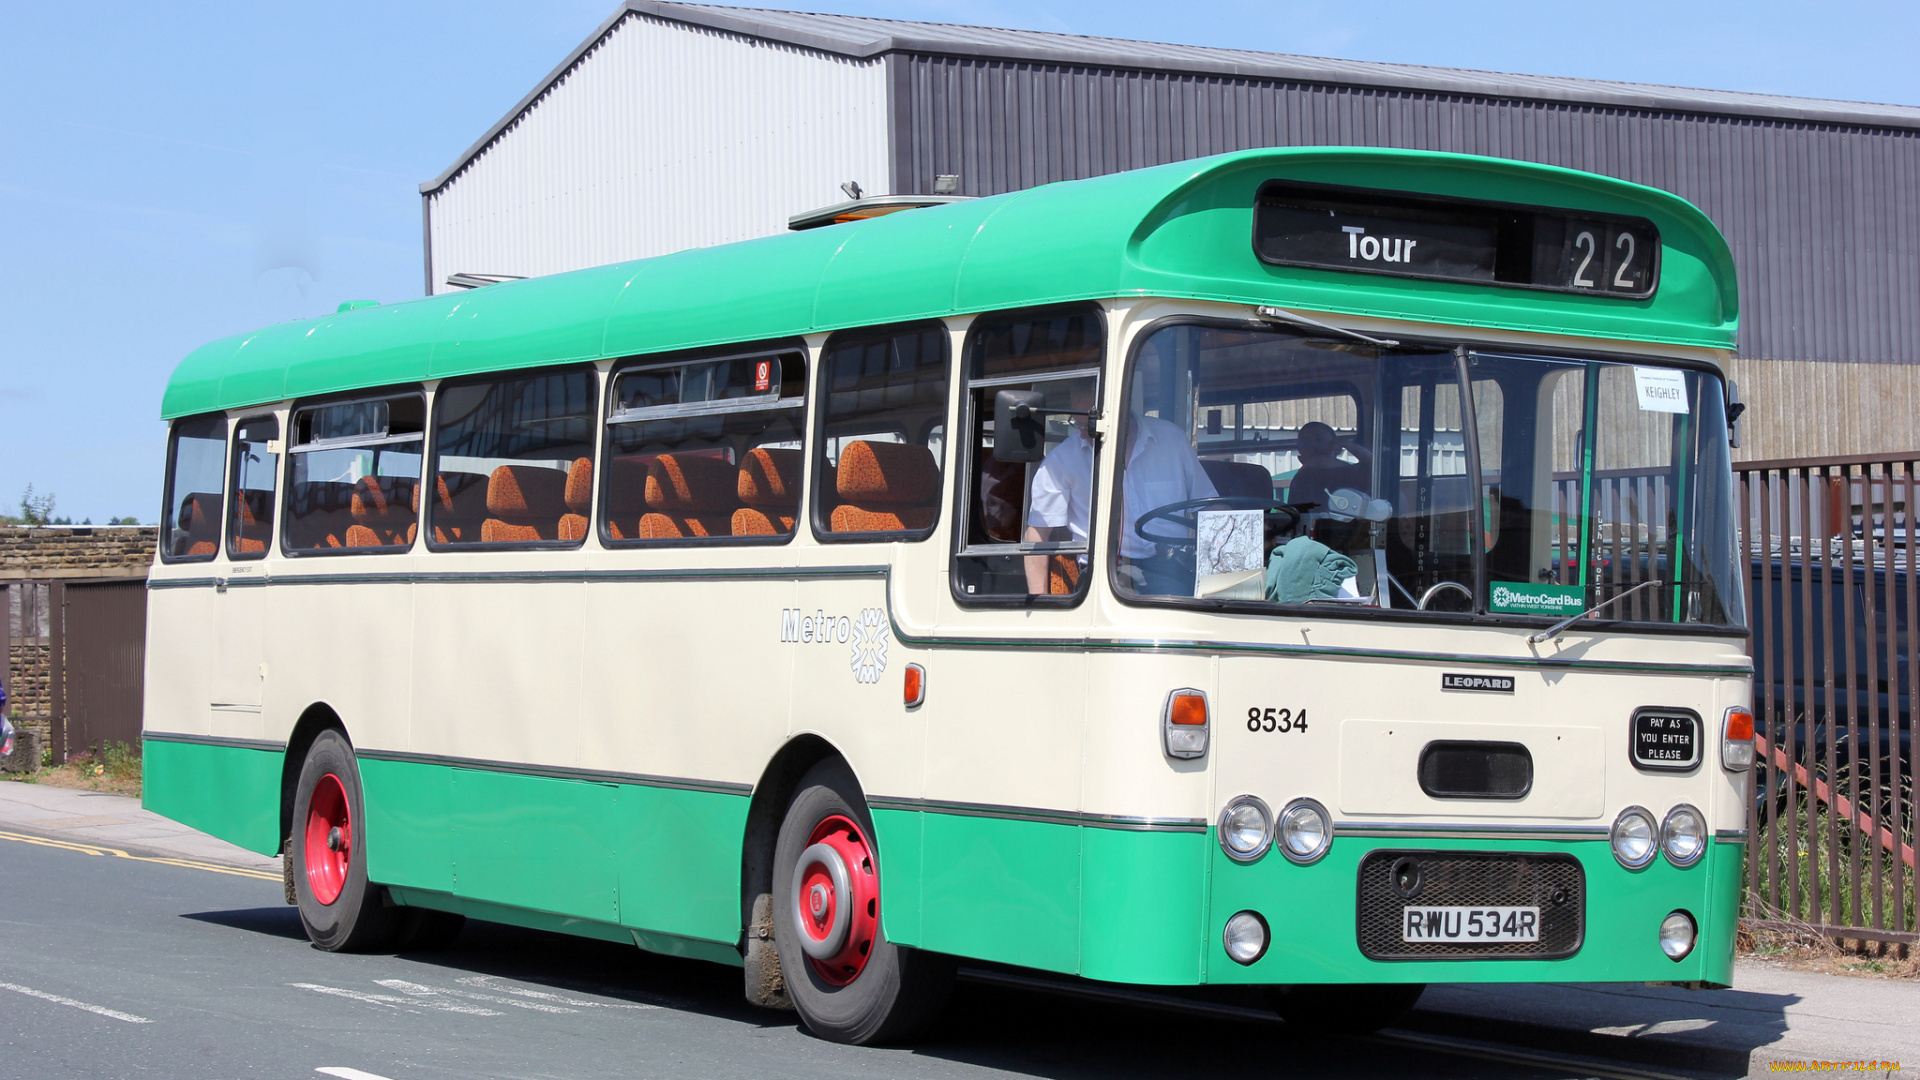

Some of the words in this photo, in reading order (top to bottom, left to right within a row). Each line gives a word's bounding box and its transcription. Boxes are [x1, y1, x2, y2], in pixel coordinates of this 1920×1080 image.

[1342, 225, 1417, 263] Tour
[1644, 385, 1680, 400] KEIGHLEY
[1509, 592, 1564, 606] MetroCard
[1564, 595, 1583, 606] Bus
[781, 608, 851, 643] Metro
[1444, 676, 1512, 689] LEOPARD
[1247, 707, 1308, 733] 8534
[1650, 718, 1665, 728] PAY
[1669, 719, 1681, 729] AS
[1641, 733, 1658, 743] YOU
[1662, 734, 1690, 745] ENTER
[1648, 749, 1681, 760] PLEASE
[1406, 911, 1462, 938] RWU
[1467, 911, 1536, 938] 534R
